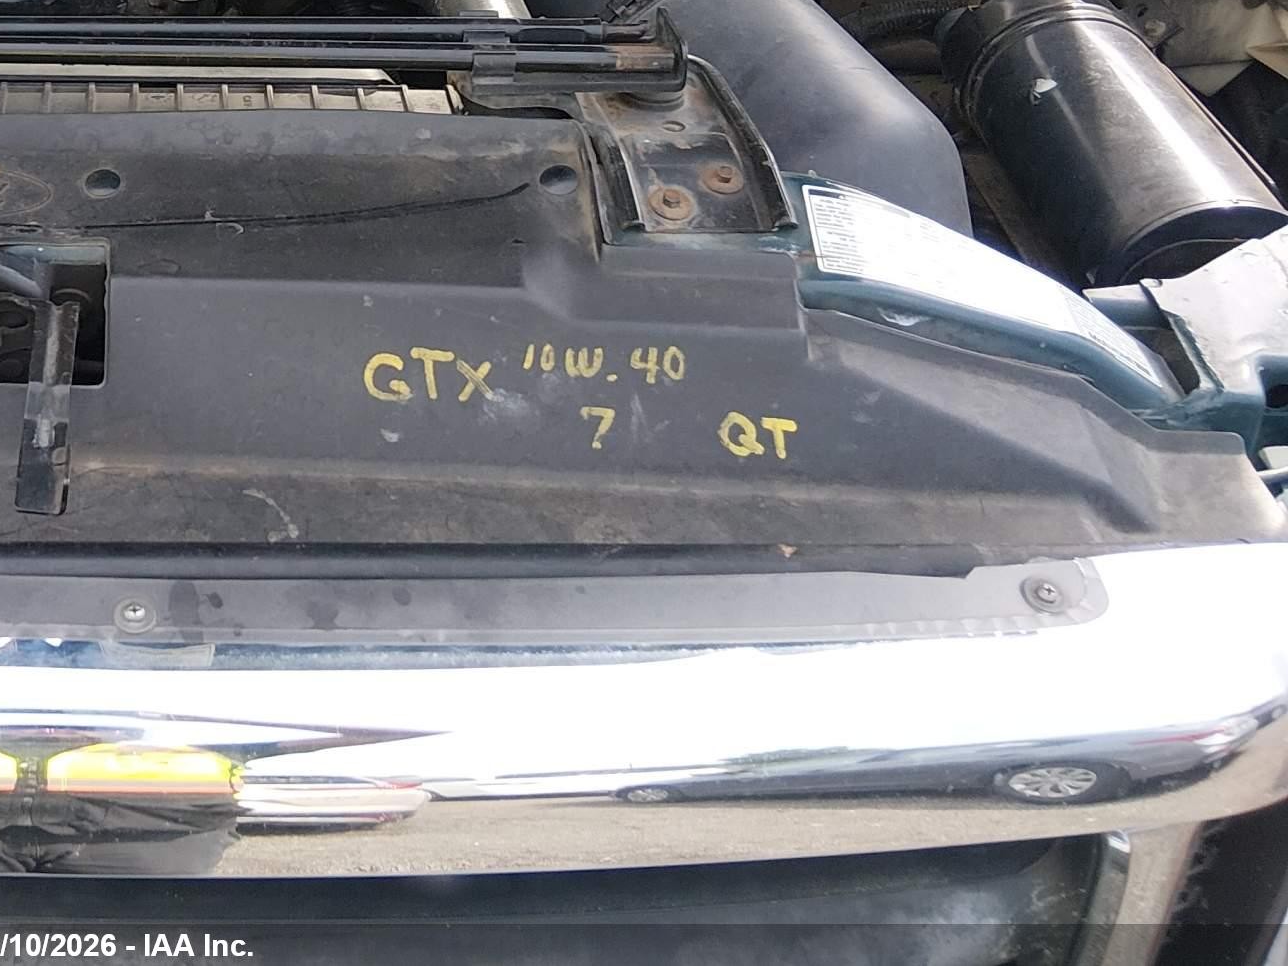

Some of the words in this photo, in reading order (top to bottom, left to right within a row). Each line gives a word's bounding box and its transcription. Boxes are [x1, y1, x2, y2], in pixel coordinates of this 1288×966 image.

[363, 346, 497, 403] GTX
[579, 405, 616, 450] 7
[716, 410, 798, 460] QT
